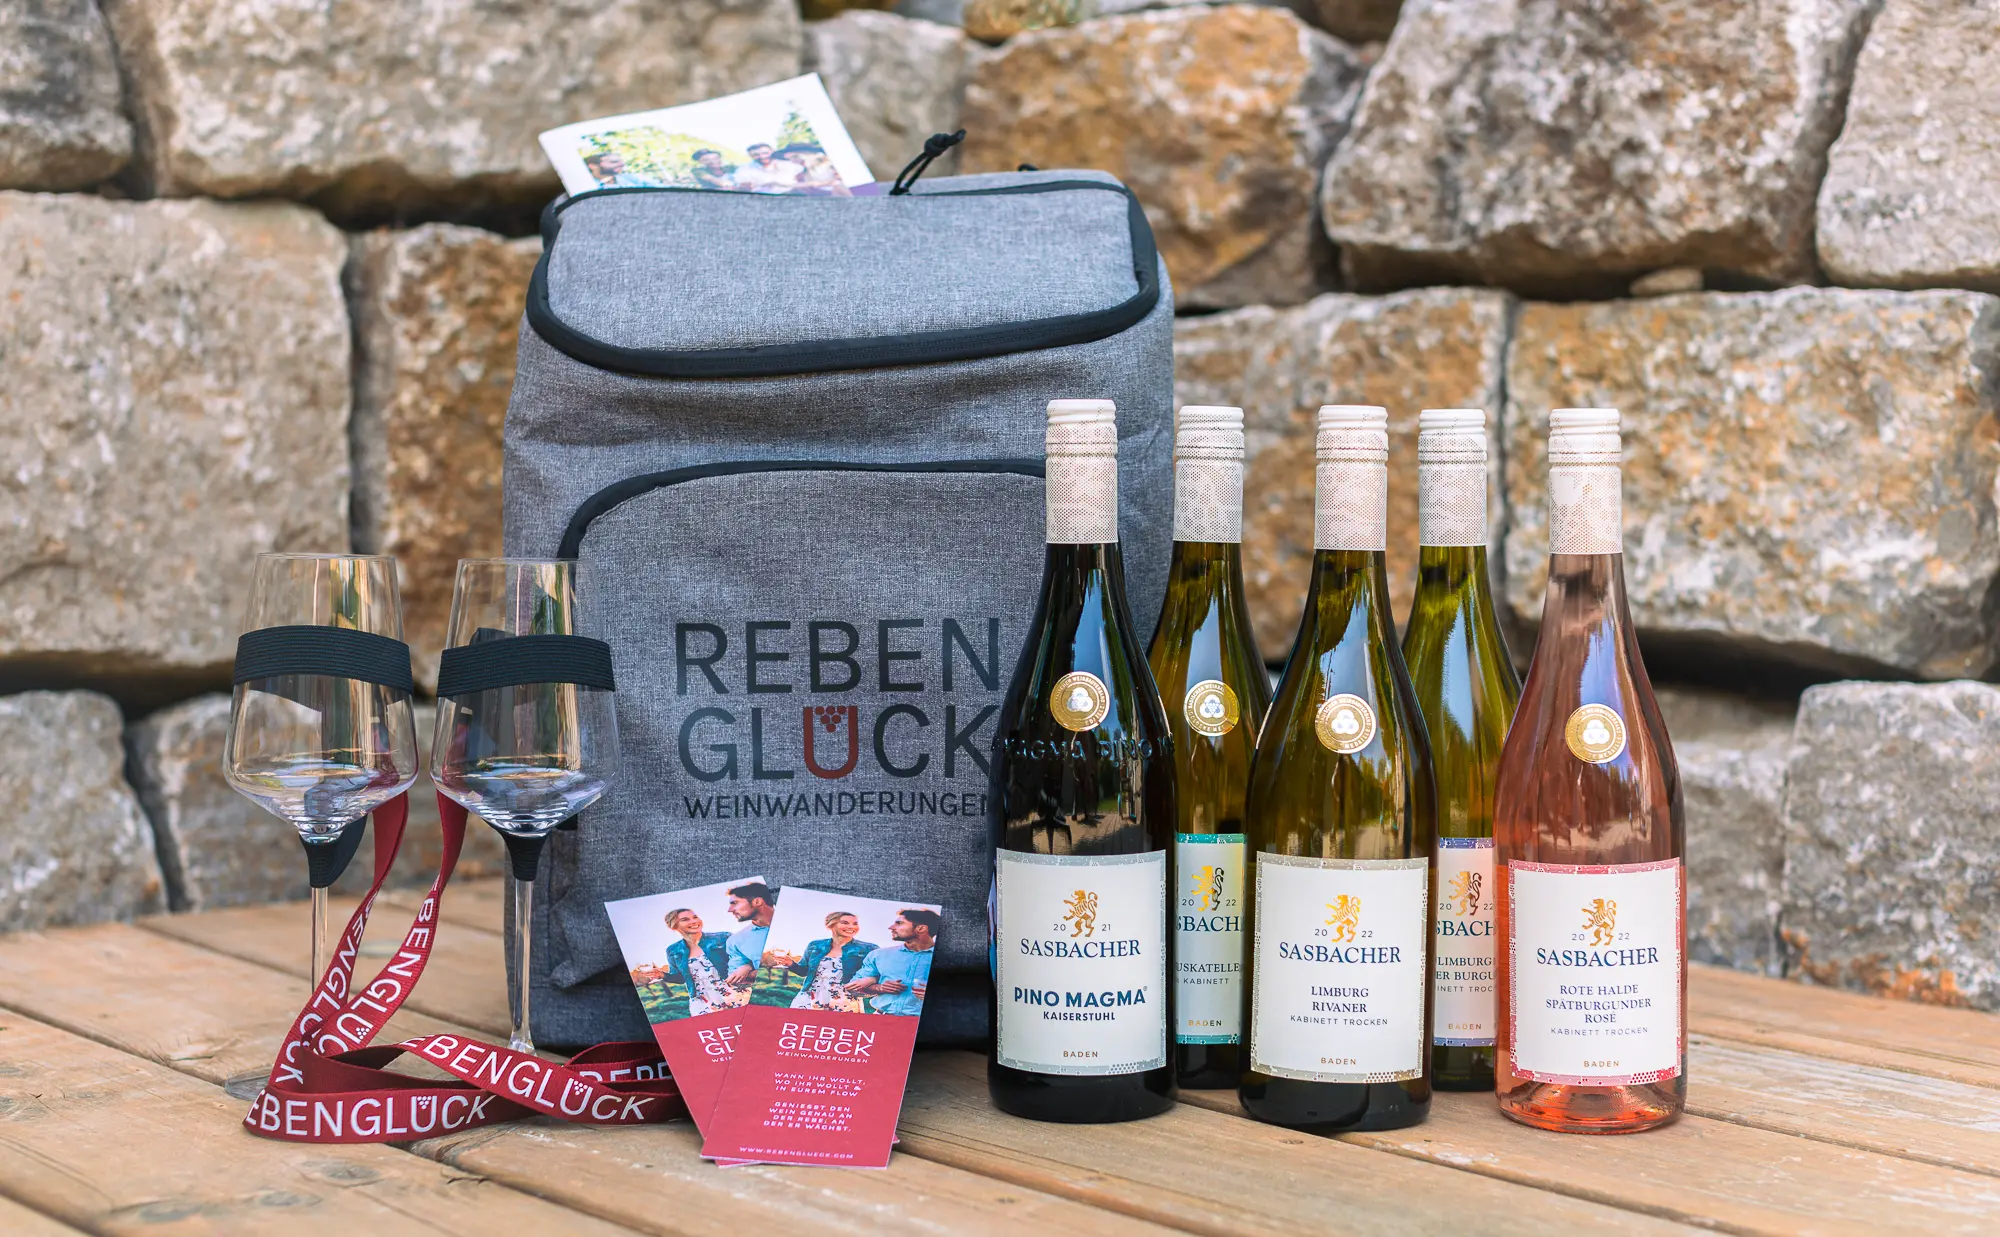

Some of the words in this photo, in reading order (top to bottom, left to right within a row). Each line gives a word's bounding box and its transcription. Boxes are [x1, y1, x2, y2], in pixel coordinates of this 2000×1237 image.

[675, 618, 999, 695] REBEN
[1053, 923, 1067, 931] 20
[1101, 923, 1111, 931] 21
[1314, 928, 1328, 936] 20
[1361, 930, 1373, 938] 22
[1571, 933, 1585, 941] 20
[1618, 932, 1630, 940] 22
[1020, 938, 1141, 958] SASBACHER
[1279, 942, 1401, 964] SASBACHER
[1536, 947, 1659, 967] SASBACHER
[1176, 962, 1240, 973] USKATELLE
[1183, 977, 1230, 985] KABINETT
[1311, 986, 1369, 997] LIMBURG
[1559, 984, 1594, 995] ROTE
[1598, 984, 1639, 995] HALDE
[1014, 986, 1060, 1007] PINO
[1311, 1001, 1368, 1013] RIVANER
[1545, 998, 1652, 1010] SPÄTBURGUNDER
[1043, 1011, 1116, 1021] KAISERSTUHL
[1290, 1015, 1338, 1025] KABINETT
[1343, 1018, 1388, 1026] TROCKEN
[1188, 1019, 1222, 1027] BADEN
[781, 1022, 876, 1044] REBEN
[1551, 1027, 1599, 1036] KABINETT
[1605, 1027, 1648, 1036] TROCKEN
[1063, 1050, 1098, 1058] BADEN
[1320, 1057, 1357, 1065] BADEN
[1583, 1060, 1619, 1068] BADEN
[774, 1072, 804, 1080] WANN
[791, 1086, 826, 1094] EUREM
[816, 1082, 849, 1090] WOLLT
[769, 1107, 796, 1115] WEIN
[800, 1110, 835, 1118] GENAU
